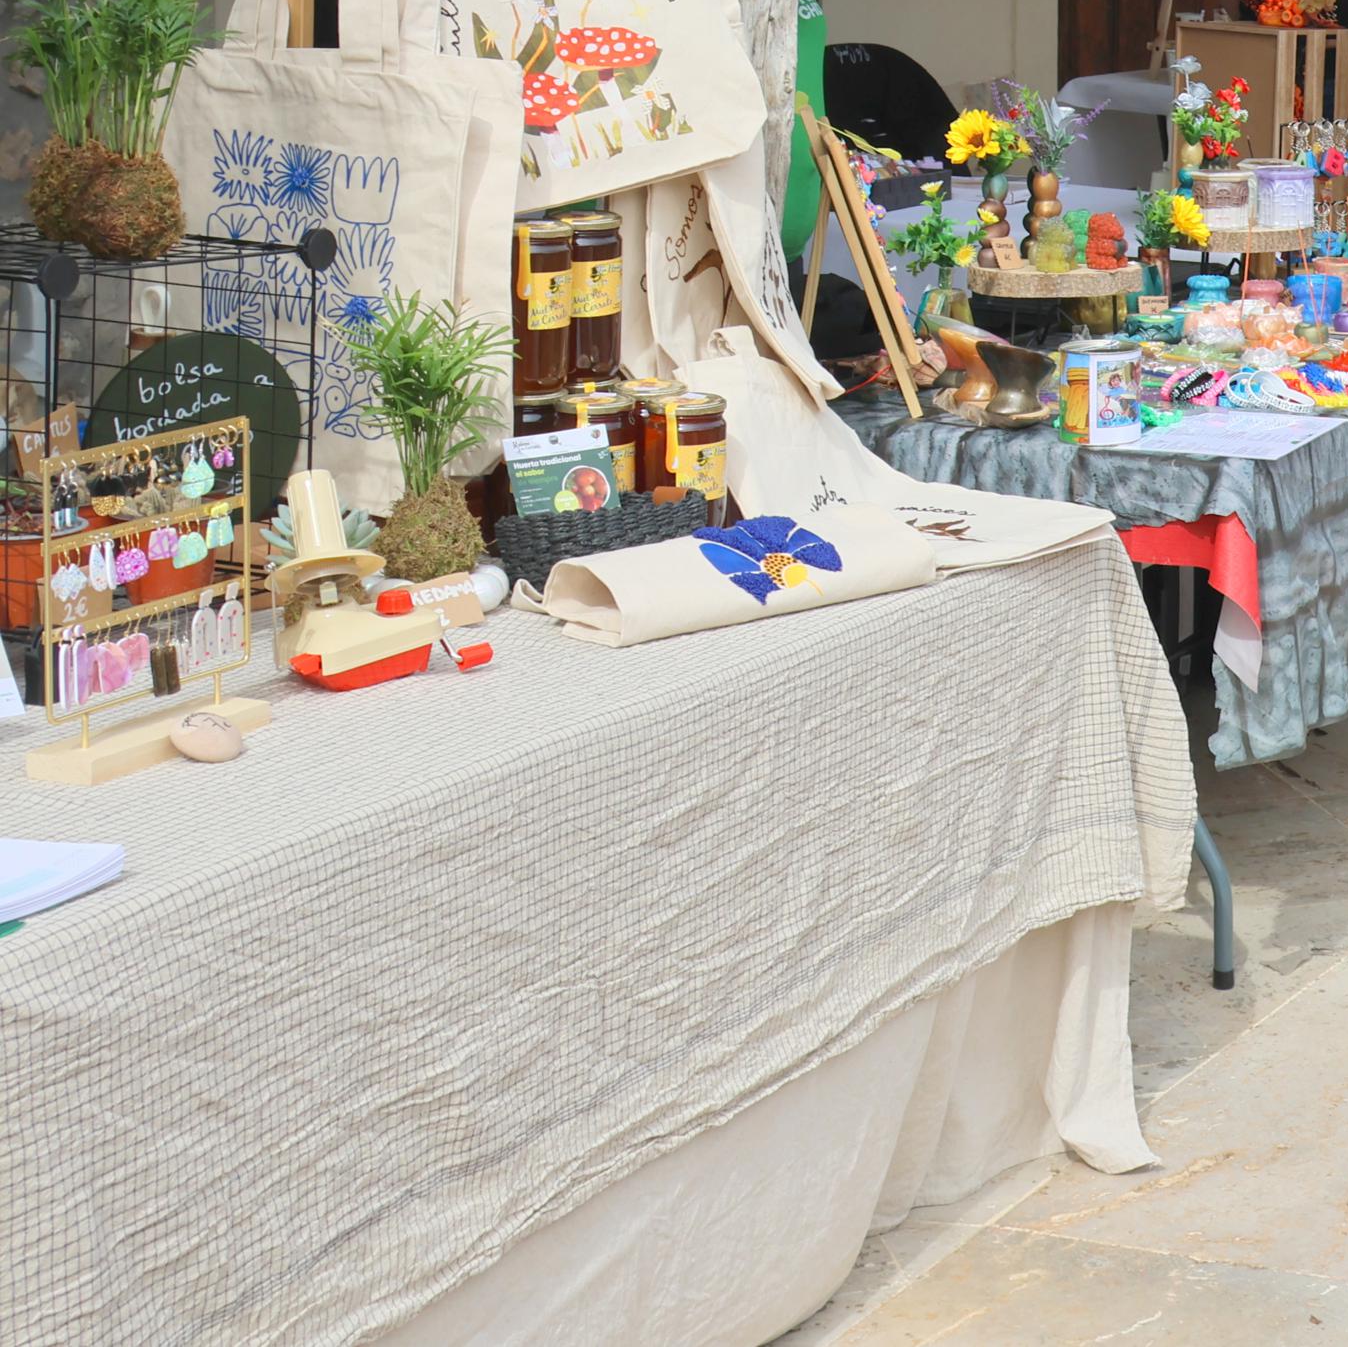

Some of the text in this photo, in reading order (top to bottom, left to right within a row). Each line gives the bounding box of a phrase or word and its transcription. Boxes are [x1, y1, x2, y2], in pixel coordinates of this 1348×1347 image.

[138, 363, 223, 403] bolsa
[22, 414, 72, 454] CATUS
[114, 393, 231, 443] bordada
[513, 454, 582, 470] Huerta tradicional
